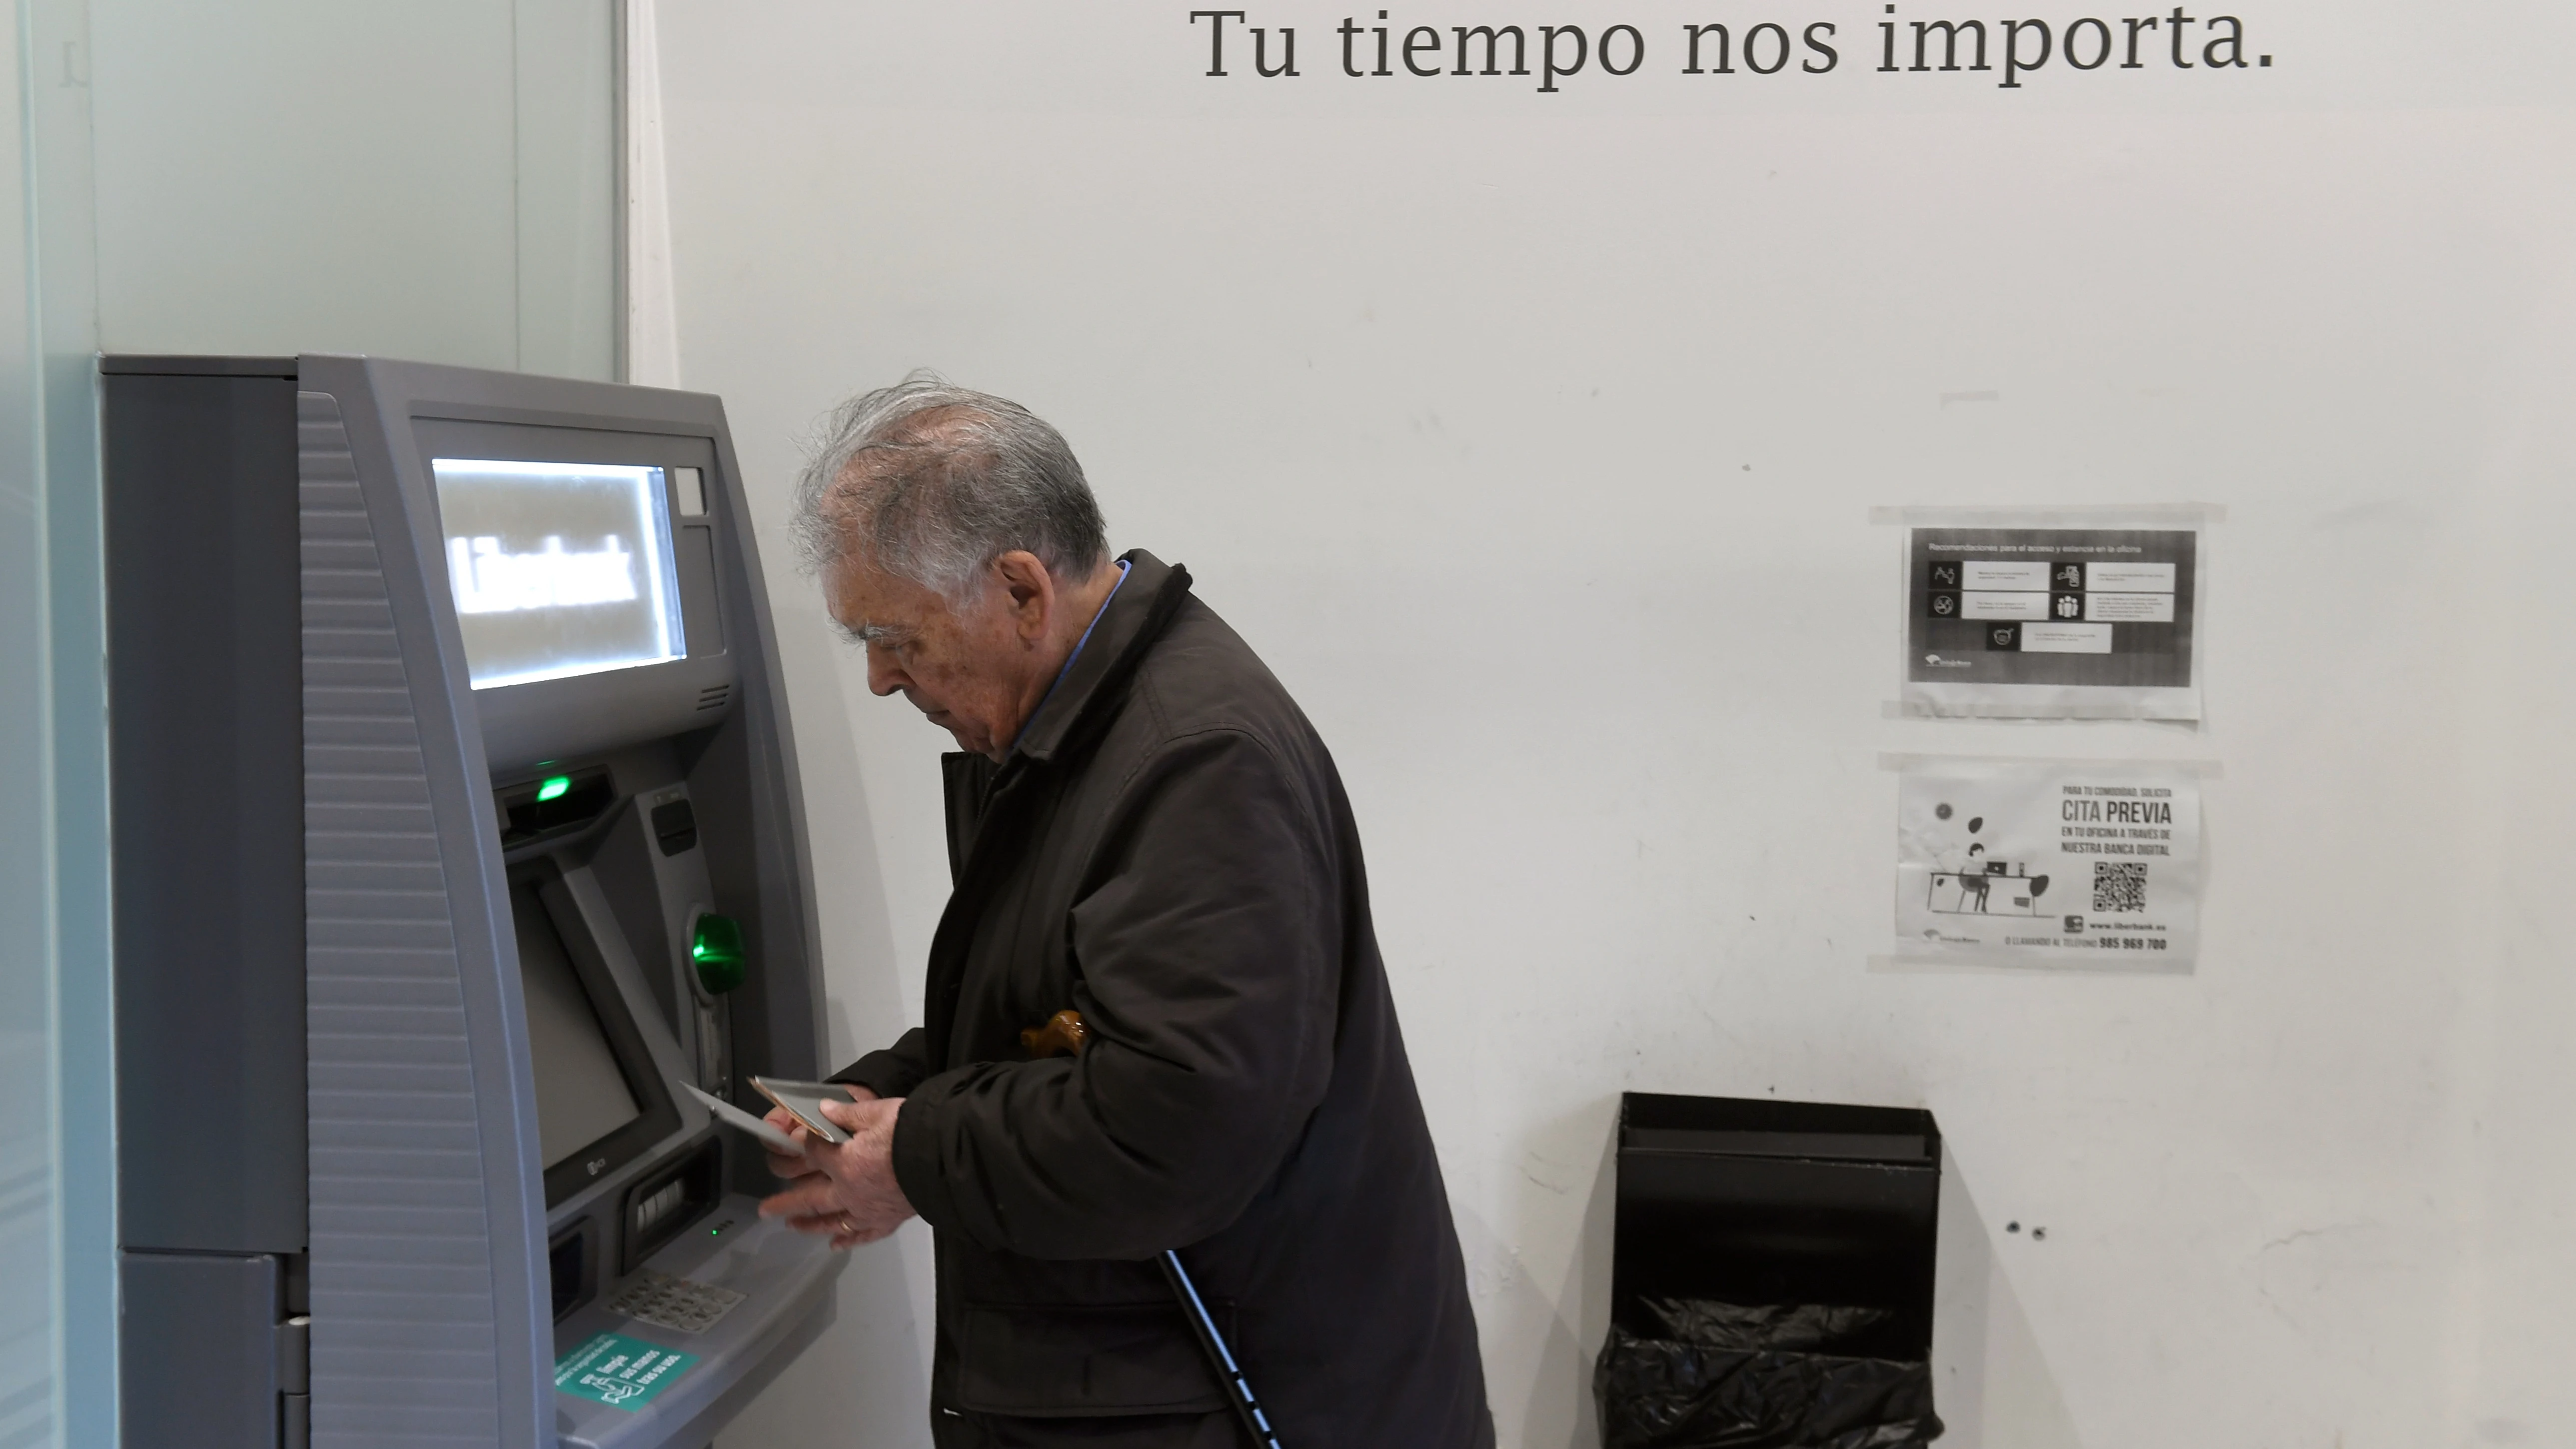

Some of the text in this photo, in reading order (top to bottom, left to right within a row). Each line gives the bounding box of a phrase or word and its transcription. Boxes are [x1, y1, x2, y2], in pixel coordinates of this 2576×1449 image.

[1190, 4, 2272, 92] Tu tiempo nos importa.
[1928, 543, 1998, 551] Recomendaciones
[2063, 785, 2082, 795] PARA
[2084, 786, 2093, 796] TU
[2140, 788, 2172, 797] SOLICITA
[2062, 799, 2172, 824] CITA PREVIA
[2061, 826, 2073, 837] EN
[2075, 827, 2085, 837] TU
[2086, 827, 2118, 838] OFICINA
[2120, 828, 2126, 838] A
[2160, 829, 2171, 840] DE
[2061, 842, 2171, 856] NUESTRA BANCA DIGITAL
[2012, 937, 2051, 947] LLAMANDO
[2053, 938, 2060, 947] AL
[2100, 937, 2120, 949] 985
[2123, 938, 2144, 950] 969
[2147, 938, 2167, 950] 700
